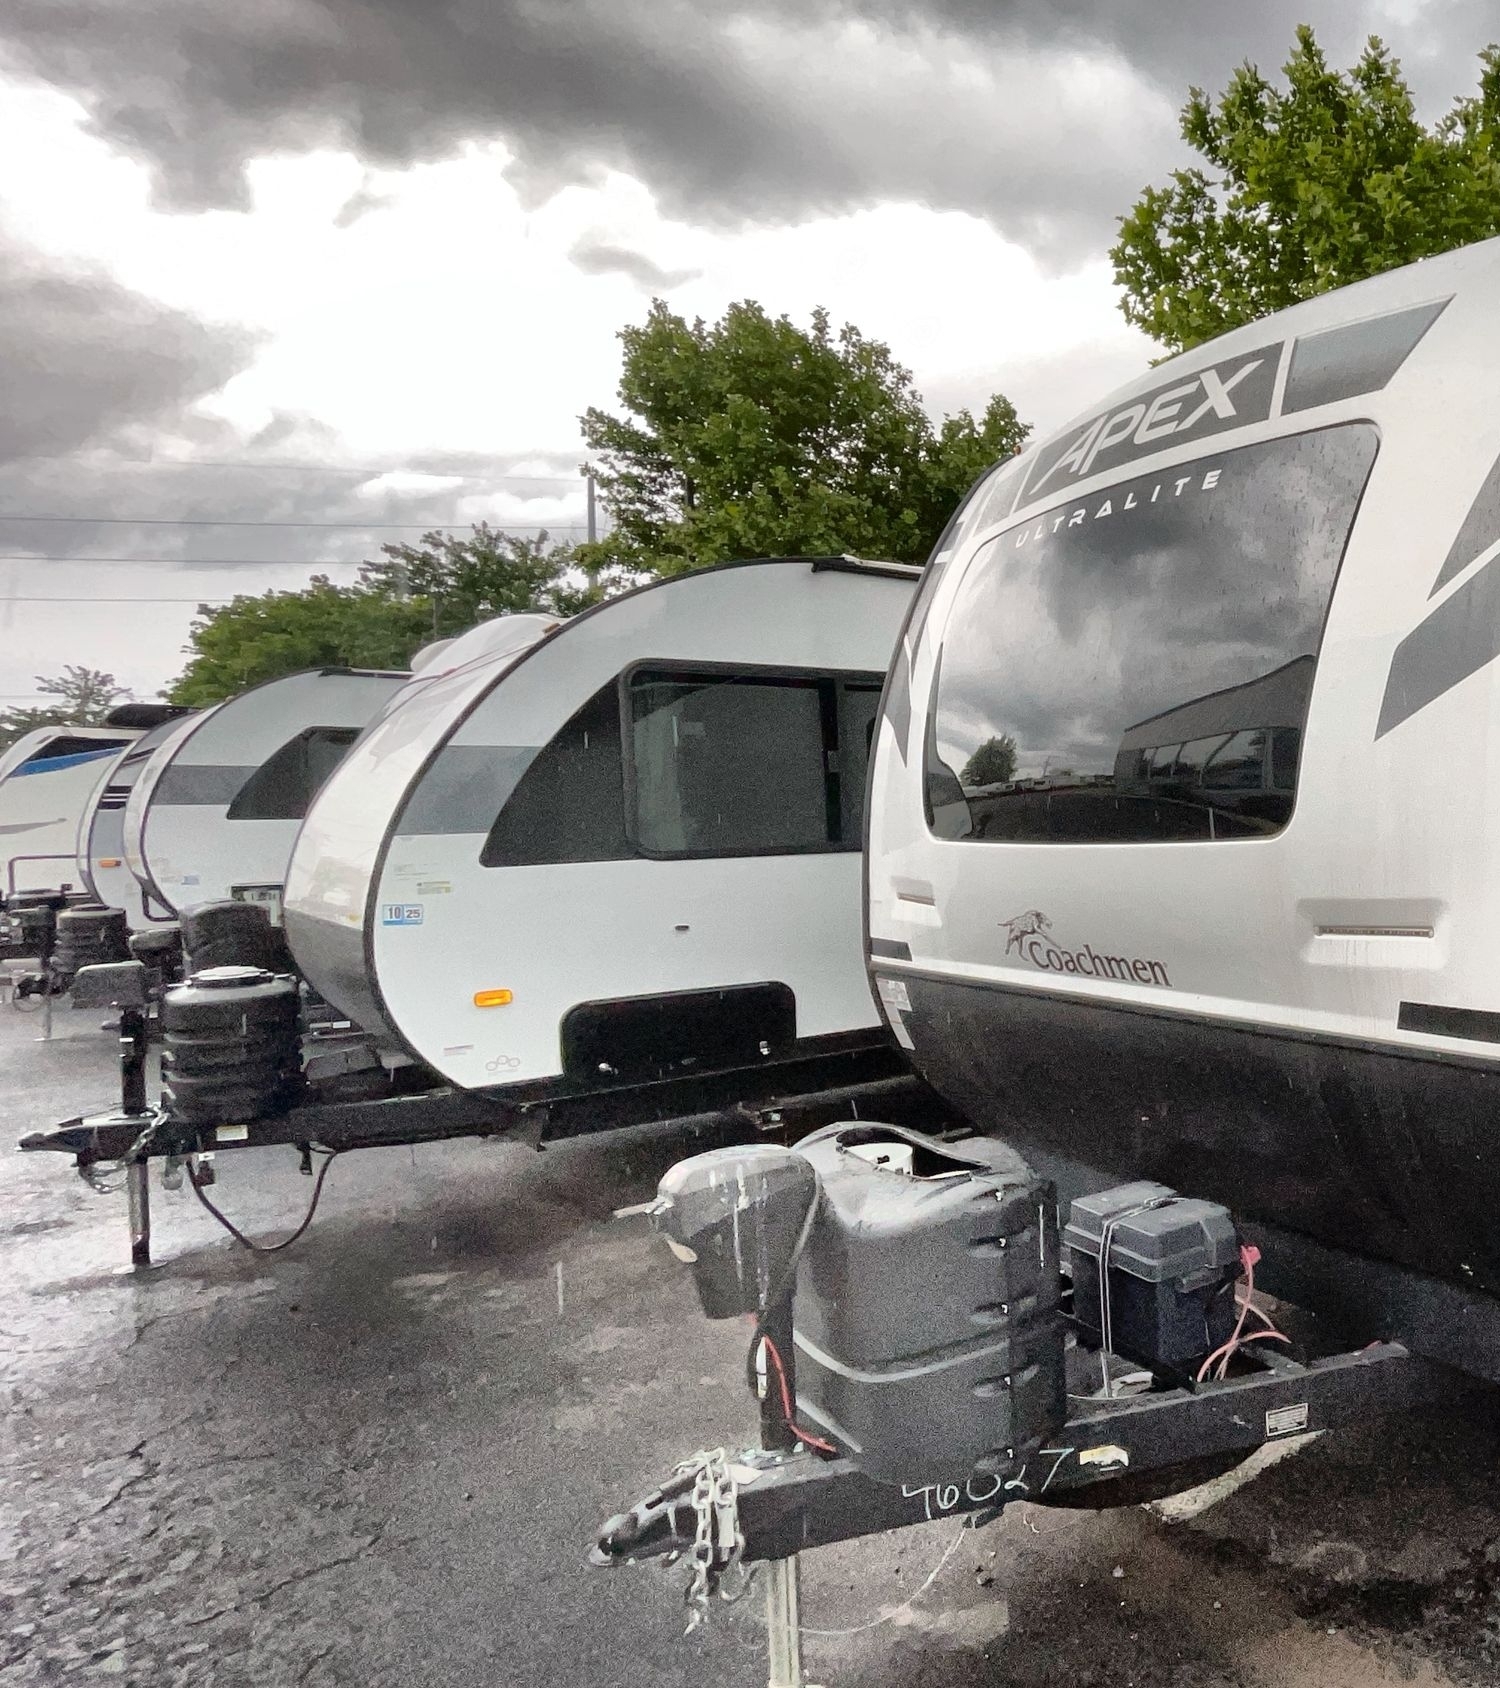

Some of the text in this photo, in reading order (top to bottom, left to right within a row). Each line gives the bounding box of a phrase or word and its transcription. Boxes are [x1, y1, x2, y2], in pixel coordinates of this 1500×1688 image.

[1031, 358, 1265, 496] APEX
[1015, 468, 1223, 549] ULTRALITE
[388, 906, 421, 919] 10 25
[1029, 939, 1172, 988] Coachmen
